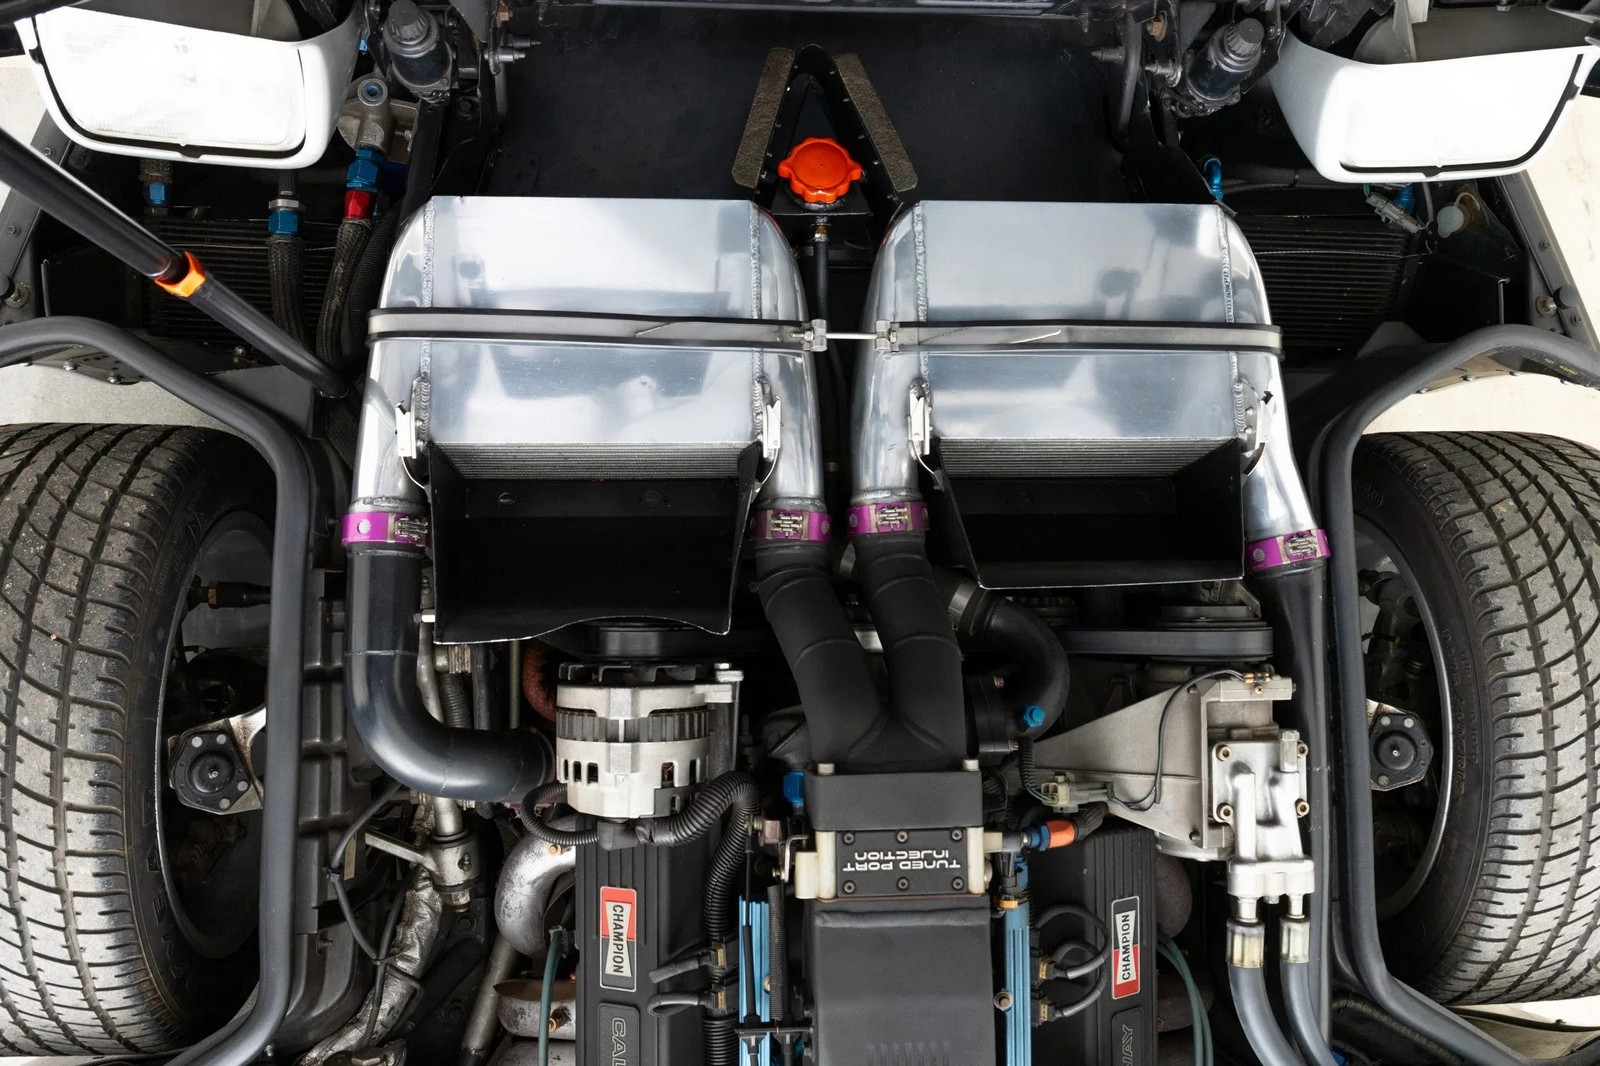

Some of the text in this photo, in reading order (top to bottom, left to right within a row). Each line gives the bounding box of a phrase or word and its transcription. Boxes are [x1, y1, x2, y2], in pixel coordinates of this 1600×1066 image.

[842, 859, 961, 872] TUNED PORT
[854, 850, 949, 861] INJECTION
[612, 904, 624, 974] CHAMPION
[1121, 913, 1131, 981] CHAMPION
